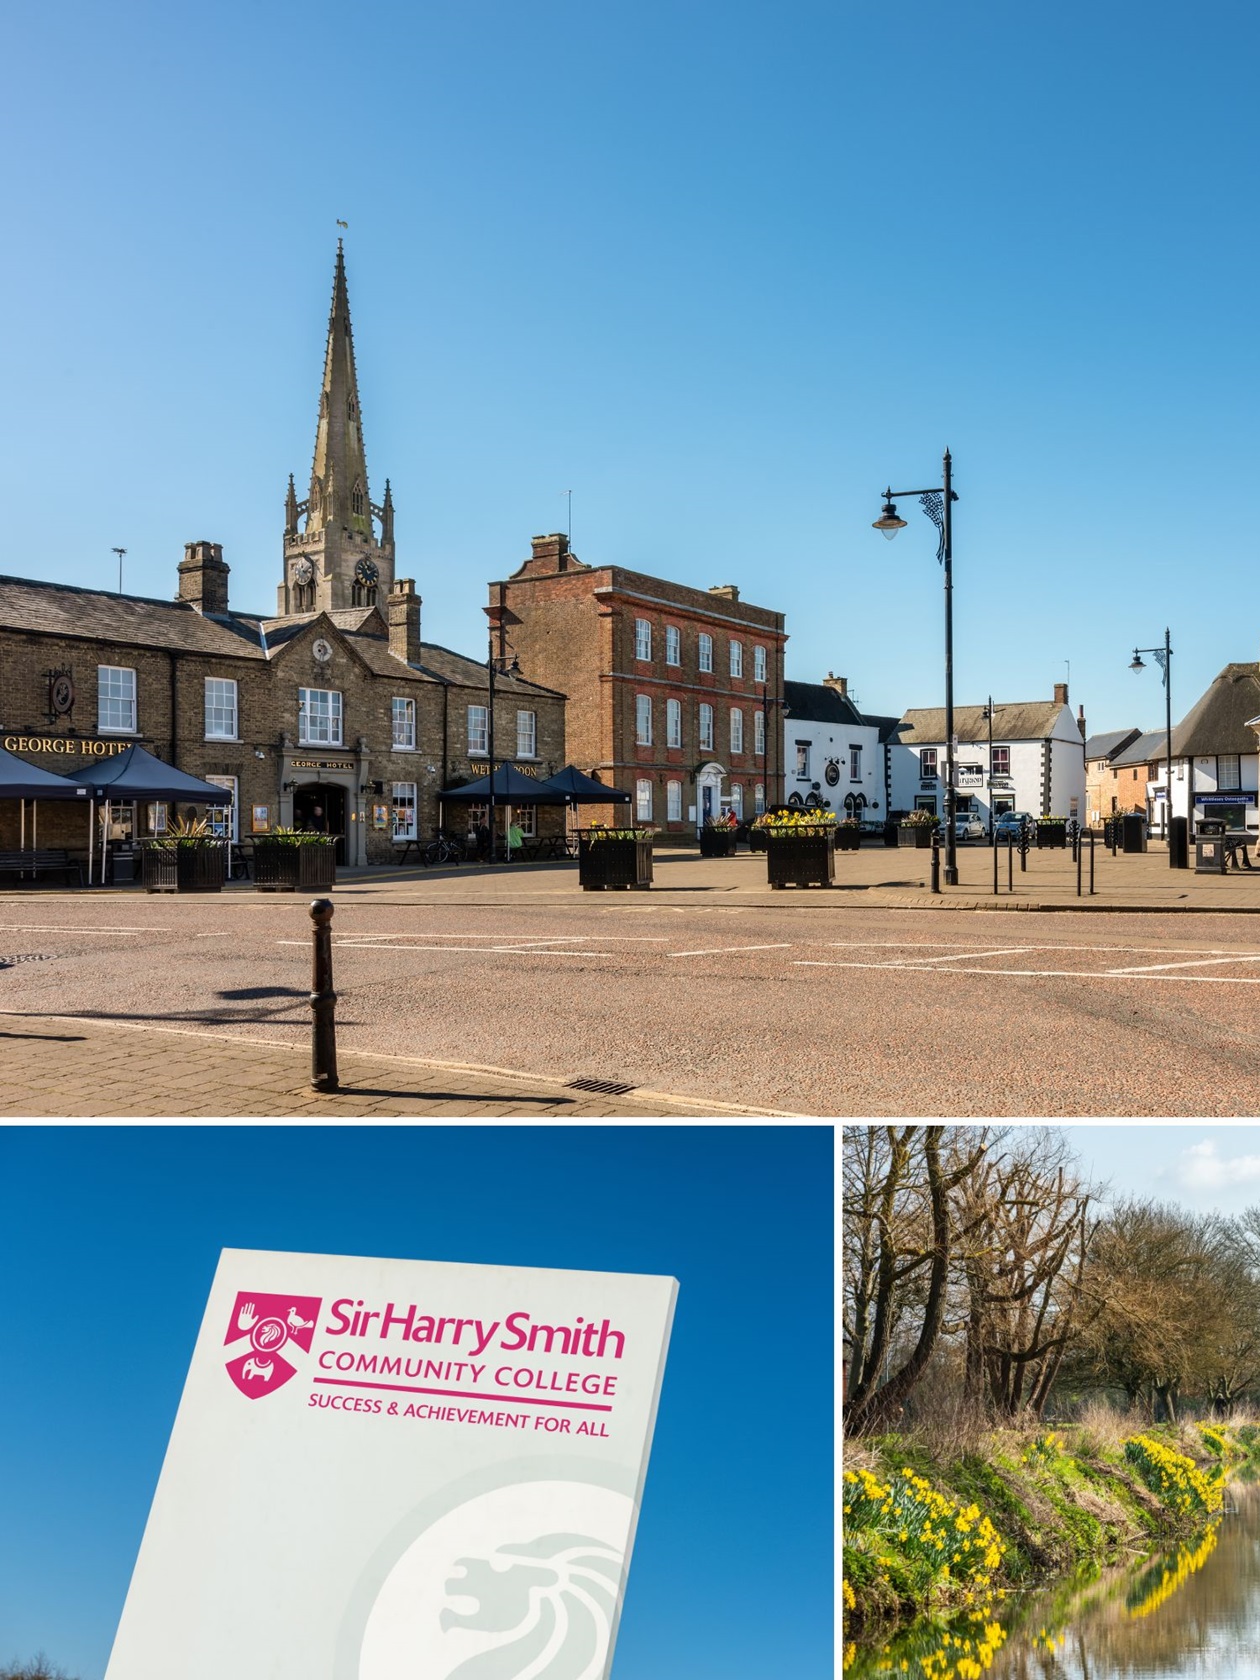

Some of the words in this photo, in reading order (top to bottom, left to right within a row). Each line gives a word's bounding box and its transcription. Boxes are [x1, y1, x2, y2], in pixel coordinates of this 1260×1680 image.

[4, 736, 75, 754] GEORGE
[81, 740, 132, 756] HOTE
[325, 1298, 380, 1337] Sir
[380, 1303, 500, 1356] Harry
[500, 1312, 625, 1359] Smith
[318, 1350, 486, 1383] COMMUNITY
[494, 1366, 618, 1396] COLLEGE
[308, 1393, 382, 1414] SUCCESS
[387, 1401, 399, 1415] &
[403, 1403, 530, 1429] ACHIEVEMENT
[534, 1416, 571, 1434] FOR
[576, 1421, 610, 1438] ALL
